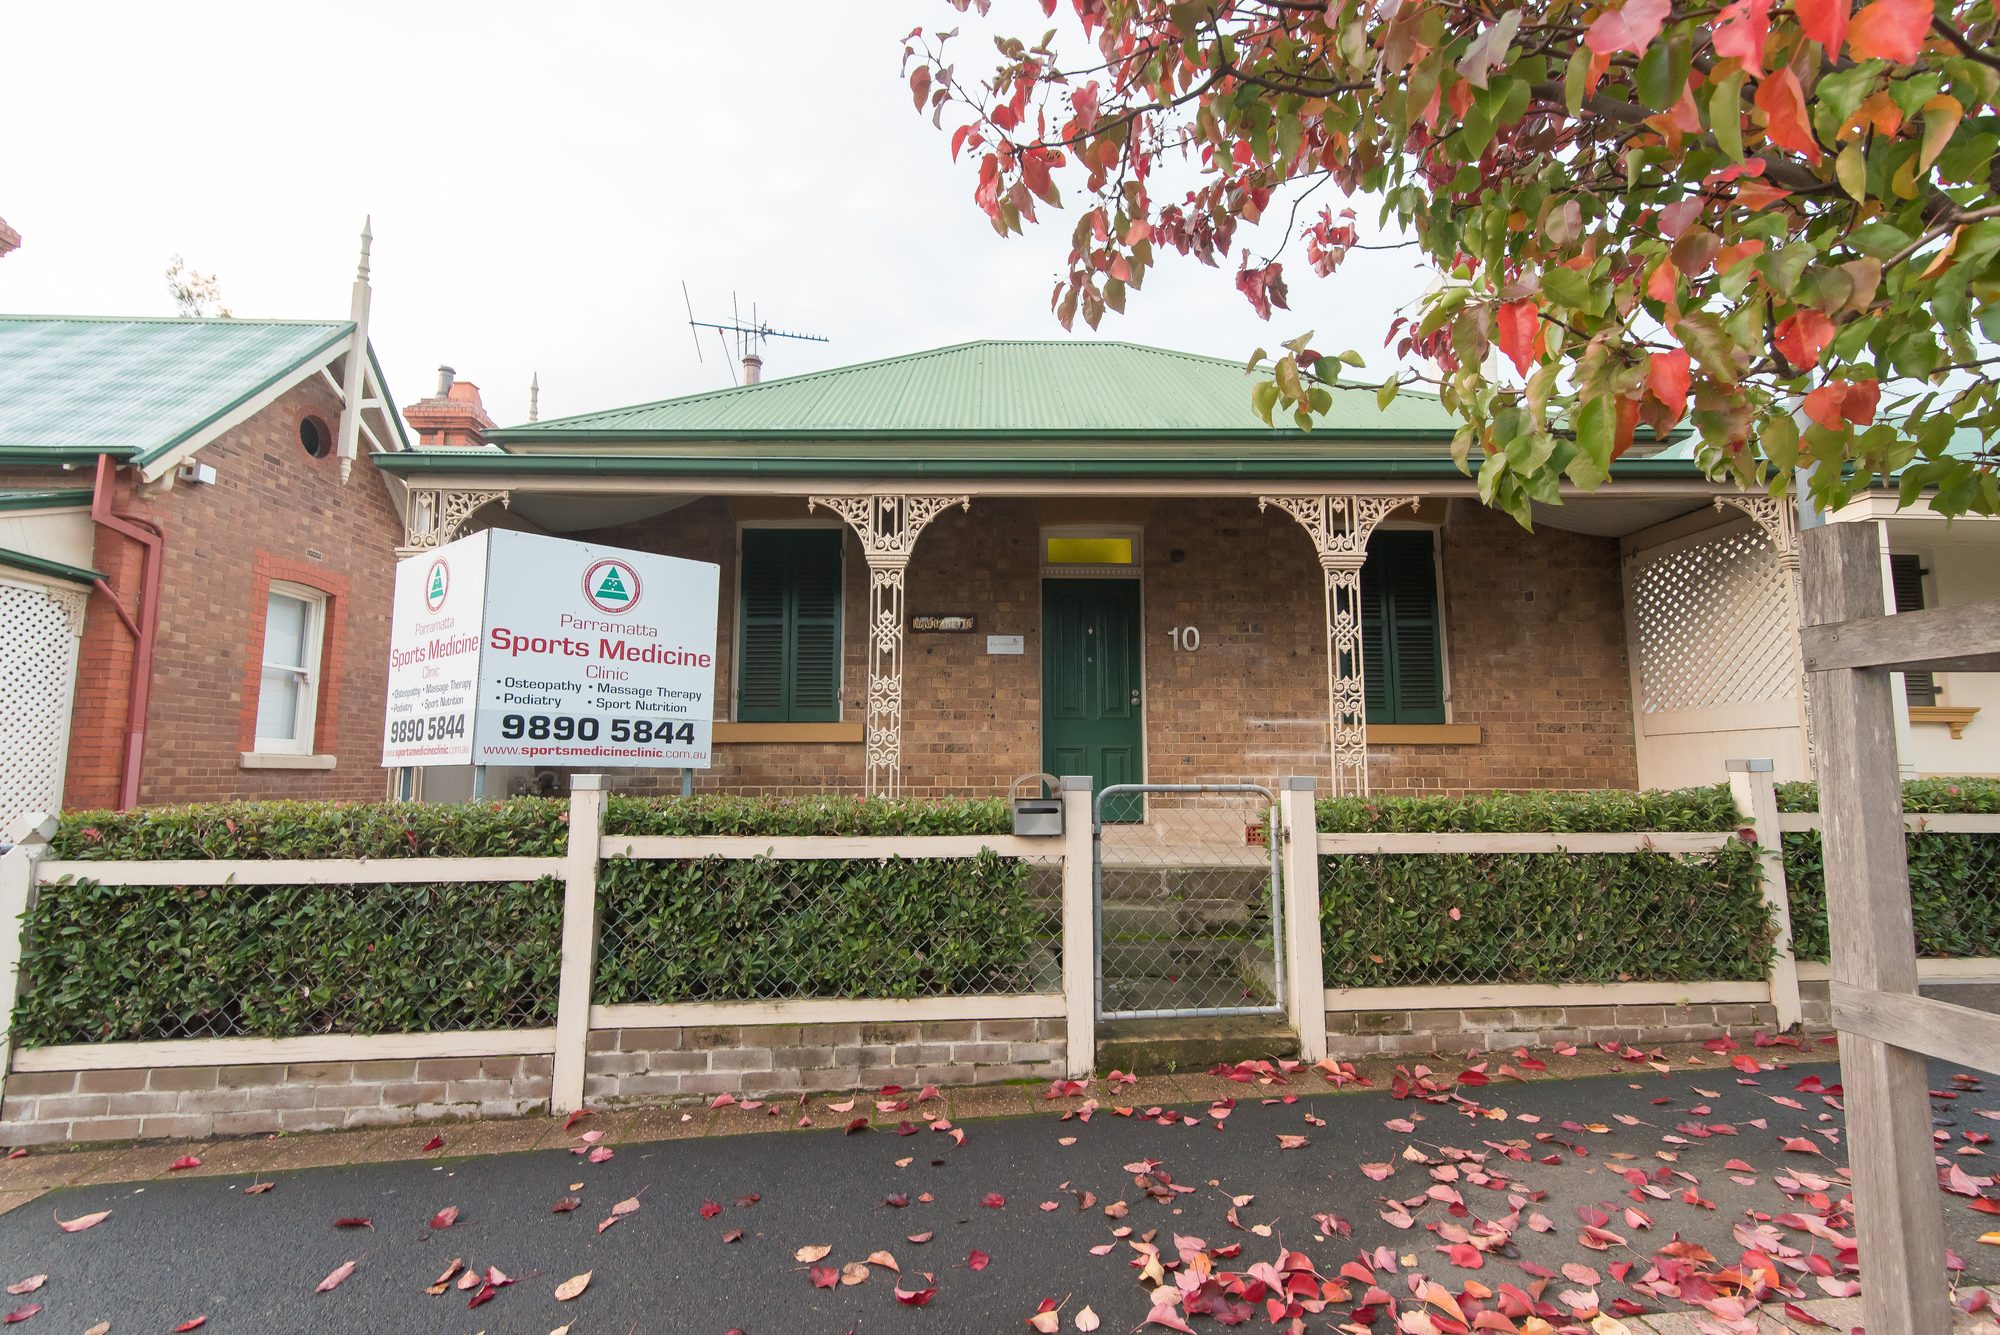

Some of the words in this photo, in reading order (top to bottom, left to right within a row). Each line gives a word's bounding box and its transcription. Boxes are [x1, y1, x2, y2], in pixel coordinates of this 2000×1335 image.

[415, 617, 455, 636] Parramatta
[560, 613, 658, 637] Parramatta
[490, 627, 590, 657] Sports
[599, 638, 711, 668] Medicine
[1167, 626, 1200, 651] 10
[392, 646, 426, 672] Sports
[428, 633, 479, 661] Medicine
[422, 664, 440, 679] Clinic
[586, 664, 629, 681] Clinic
[425, 683, 449, 694] Massage
[450, 680, 472, 691] Therapy
[504, 677, 582, 694] Osteopathy
[597, 682, 653, 698] Massage
[657, 687, 702, 702] Therapy
[424, 699, 439, 711] Sport
[440, 695, 464, 707] Nutrition
[504, 693, 561, 708] Podiatry
[596, 697, 631, 711] Sport
[635, 700, 687, 713] Nutrition
[391, 718, 425, 743] 9890
[427, 713, 465, 741] 5844
[502, 714, 600, 741] 9890
[611, 719, 695, 745] 5844
[483, 746, 706, 760] www.sportsmedicineclinic.com.au
